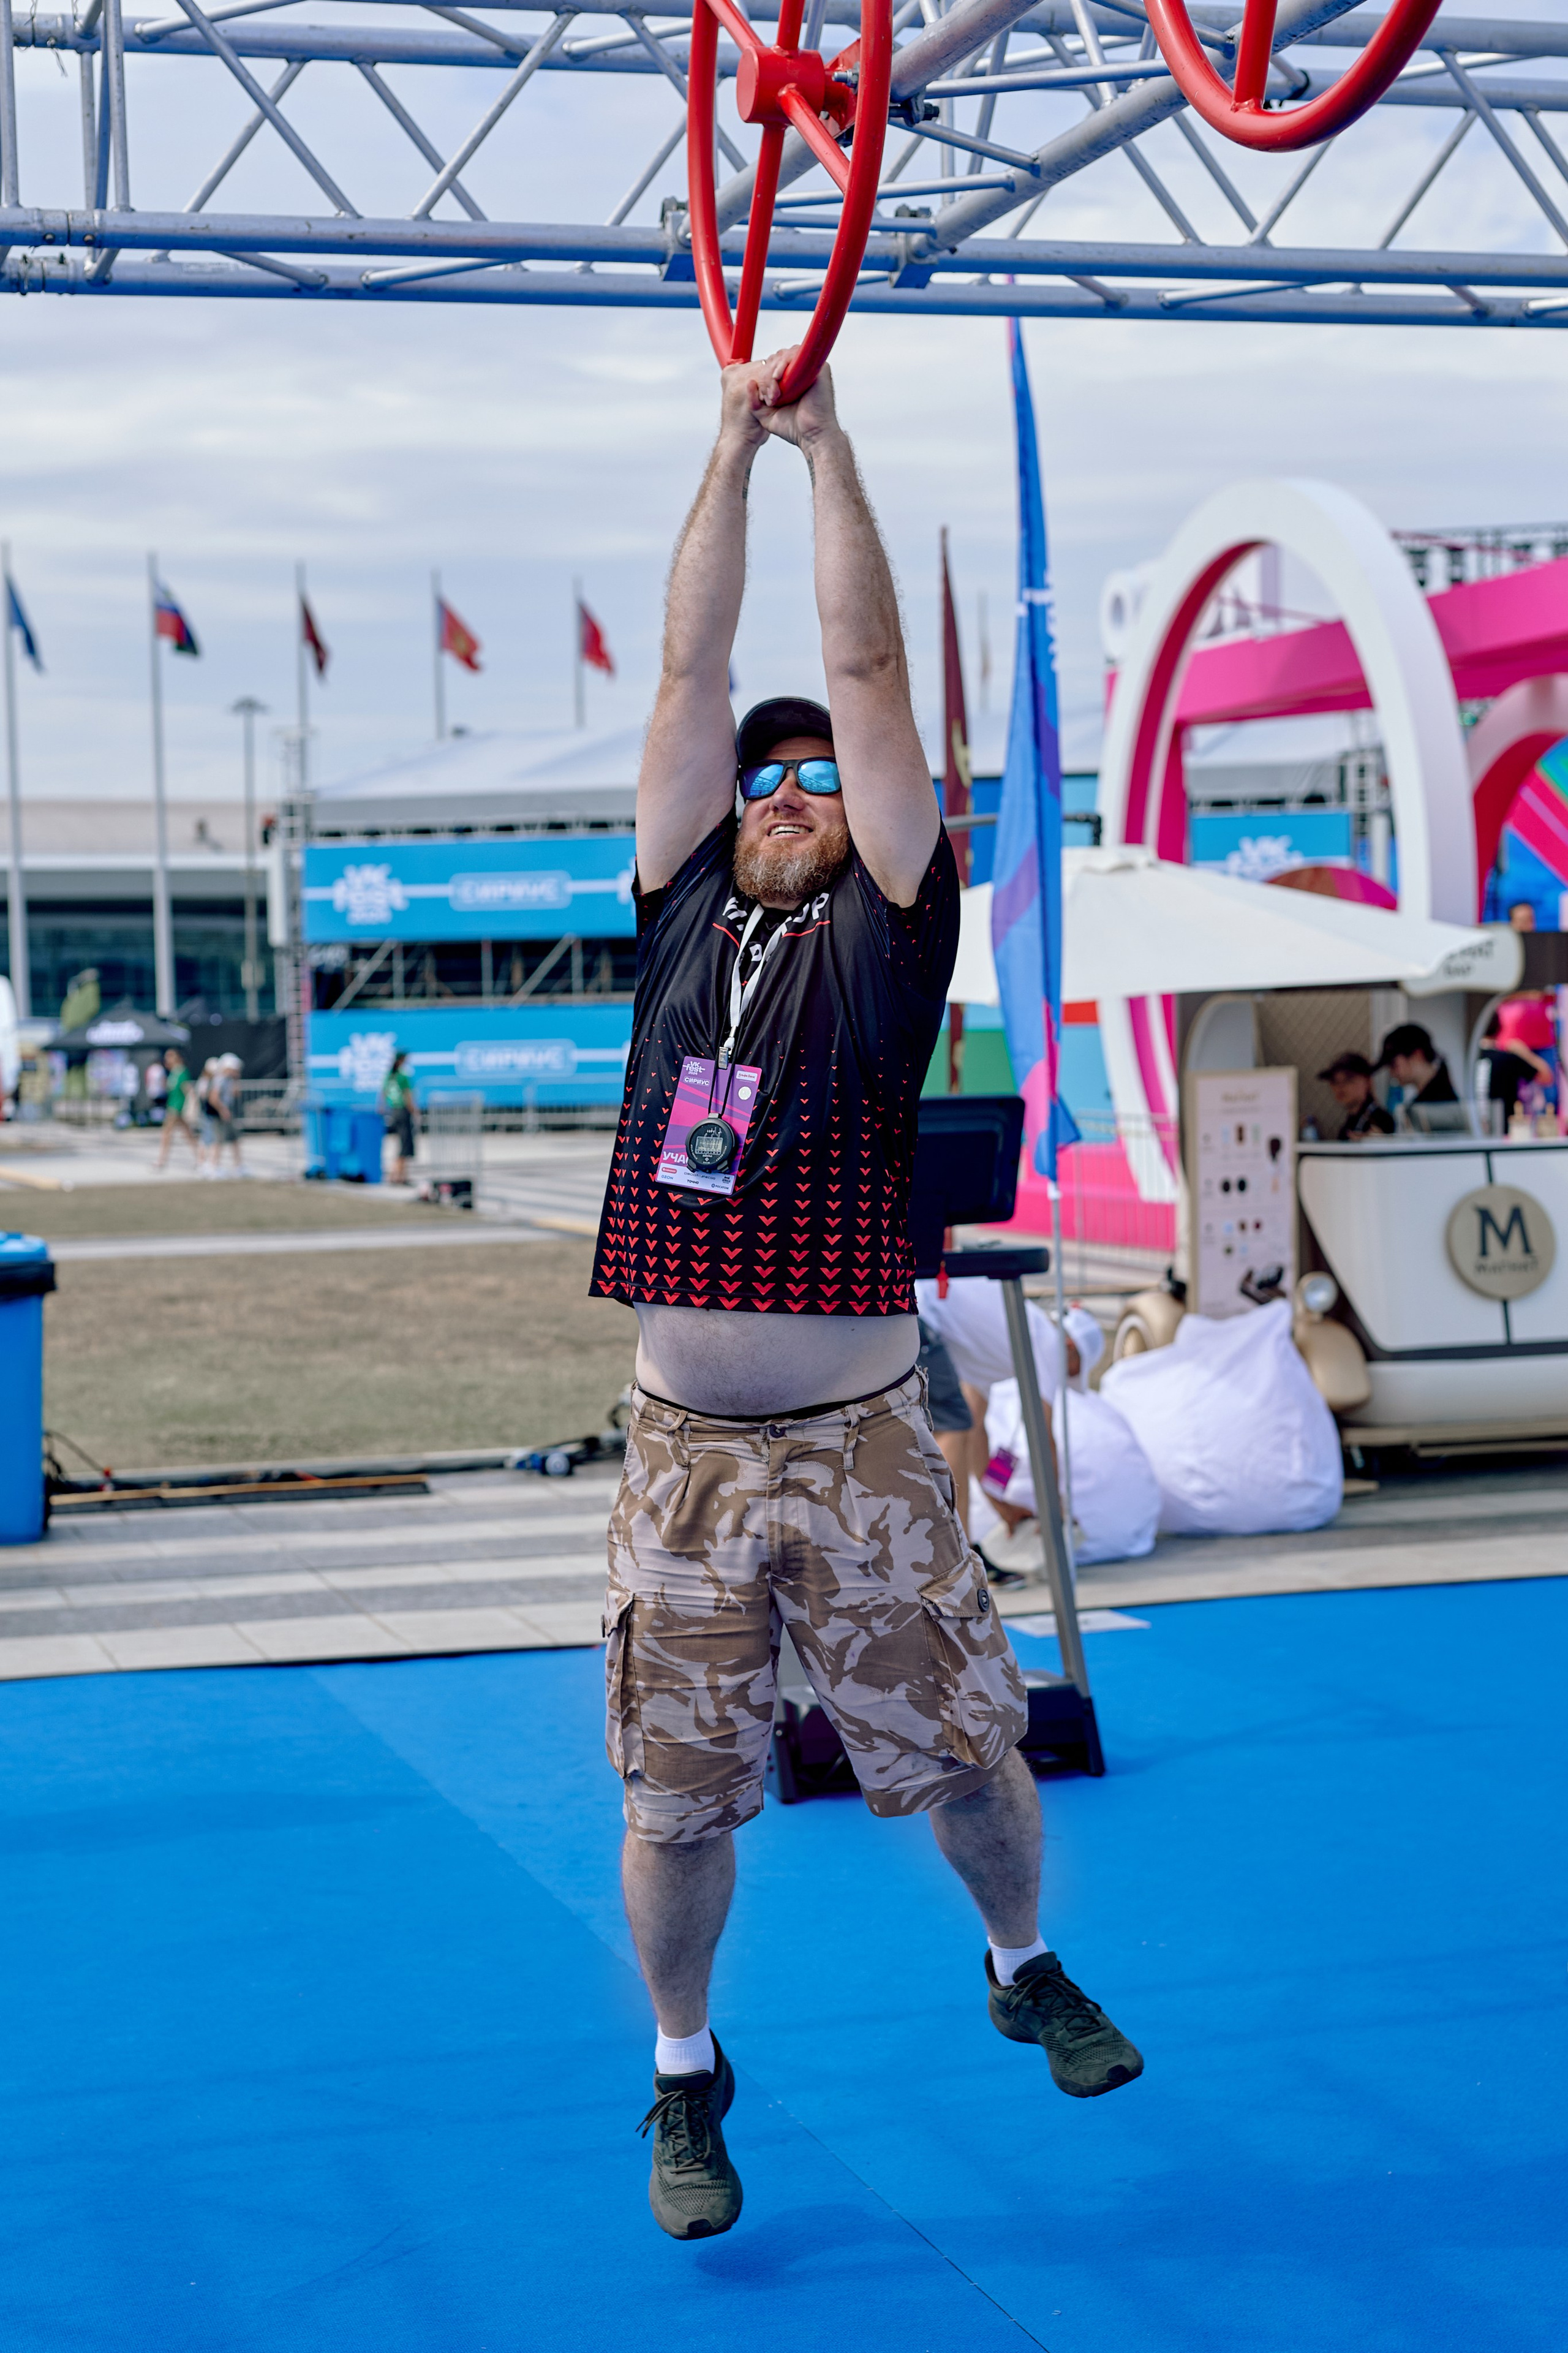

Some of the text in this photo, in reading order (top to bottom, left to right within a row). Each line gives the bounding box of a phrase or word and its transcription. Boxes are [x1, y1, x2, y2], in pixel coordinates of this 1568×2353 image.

[684, 1063, 705, 1073] fest
[663, 1151, 688, 1164] УЧА
[1475, 1206, 1532, 1256] M
